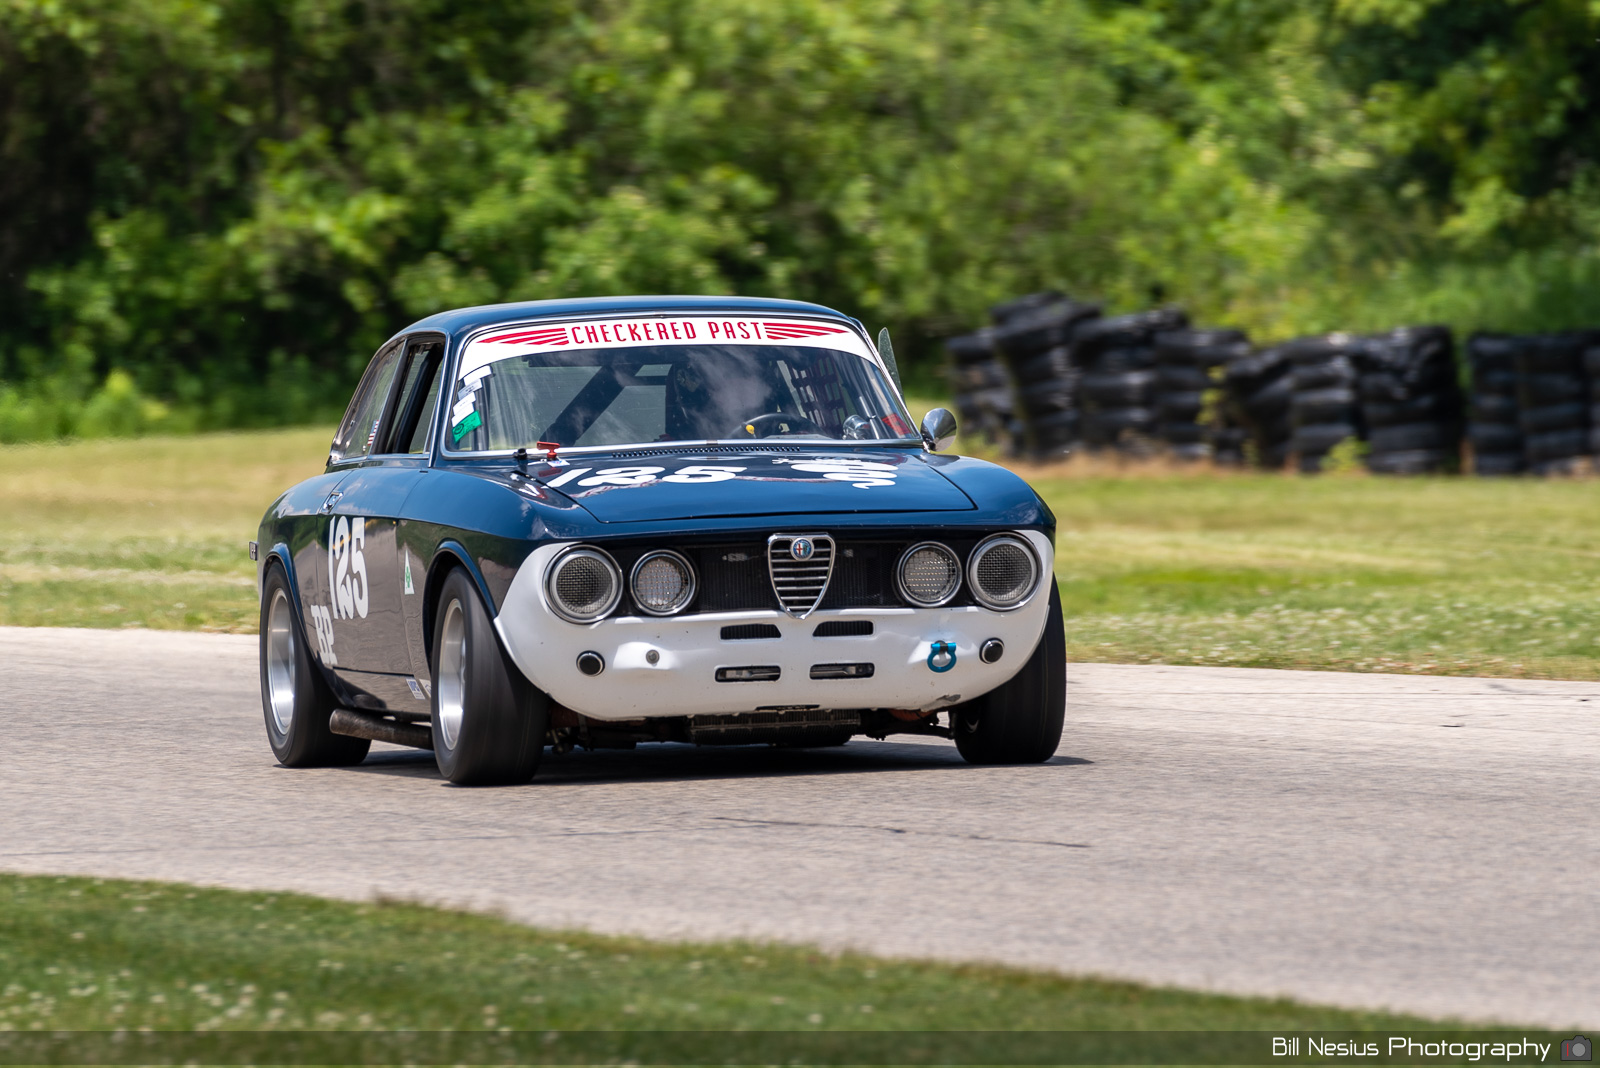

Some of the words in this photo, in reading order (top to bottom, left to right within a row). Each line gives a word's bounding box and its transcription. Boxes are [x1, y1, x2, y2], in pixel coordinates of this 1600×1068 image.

[571, 321, 697, 344] CHECKERED
[707, 321, 762, 340] PAST
[541, 465, 748, 489] 125
[328, 515, 369, 620] 125
